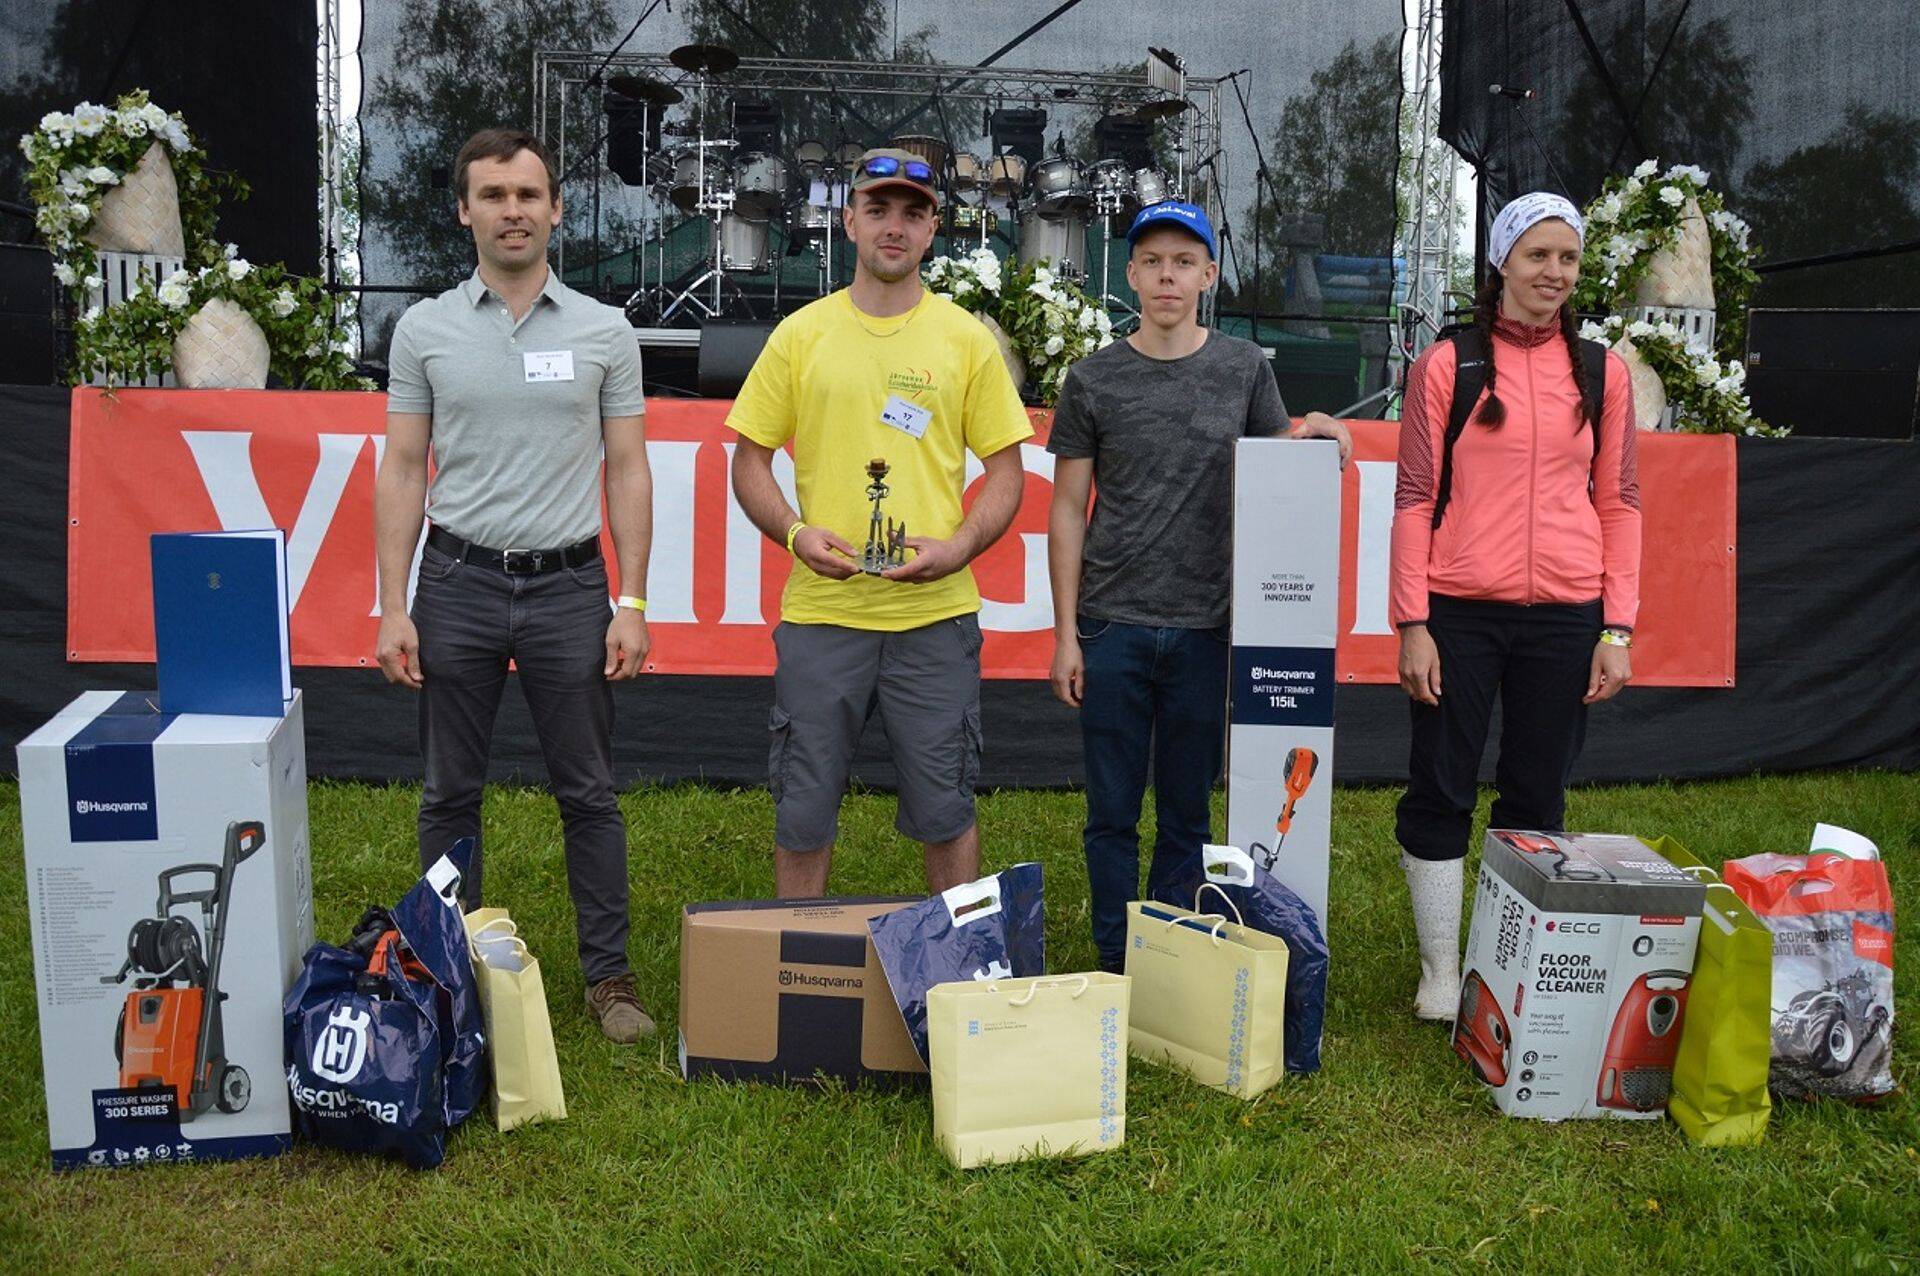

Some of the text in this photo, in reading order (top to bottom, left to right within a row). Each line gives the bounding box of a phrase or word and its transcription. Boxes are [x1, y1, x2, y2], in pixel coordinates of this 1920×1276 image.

[545, 361, 551, 370] 7
[1279, 582, 1304, 591] YEARS
[1264, 593, 1312, 602] INNOVATION
[1262, 668, 1316, 681] Husqvarna
[1252, 684, 1315, 695] BATTERY TRIMMER
[89, 800, 148, 813] Husqvarna
[1510, 904, 1524, 959] FLOOR
[1559, 922, 1601, 934] ECG
[1539, 953, 1591, 967] FLOOR
[793, 973, 863, 988] Husqvarna
[1538, 967, 1607, 981] VACUUM
[1535, 980, 1605, 994] CLEANER
[97, 1094, 174, 1106] PRESSURE WASHER
[287, 1063, 400, 1124] Husqvna
[105, 1104, 169, 1118] 300 SERIES
[318, 1110, 347, 1118] WHEN
